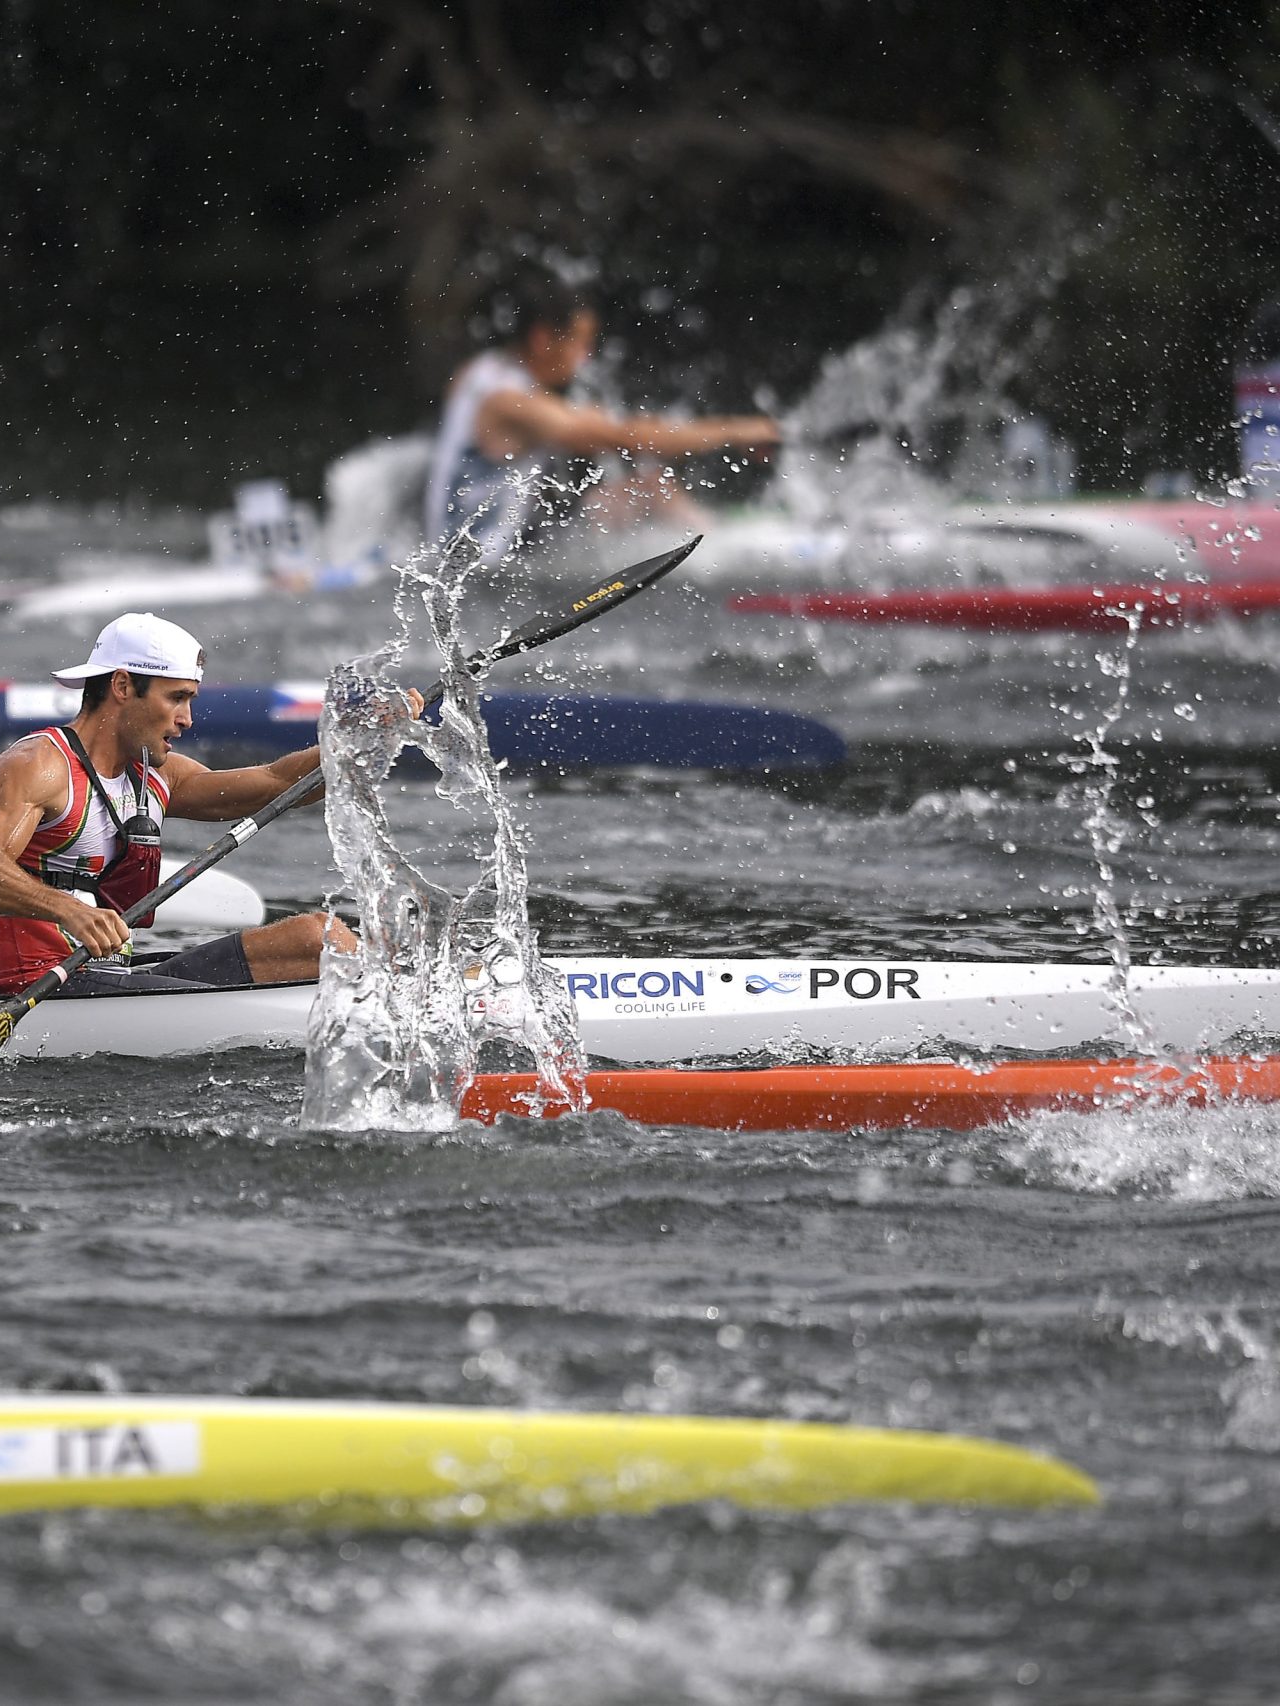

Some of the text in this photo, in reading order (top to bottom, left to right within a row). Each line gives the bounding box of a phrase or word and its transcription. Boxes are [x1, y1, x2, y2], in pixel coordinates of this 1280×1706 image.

[810, 968, 921, 999] POR
[615, 1002, 706, 1014] COOLING LIFE
[55, 1425, 162, 1477] ITA
